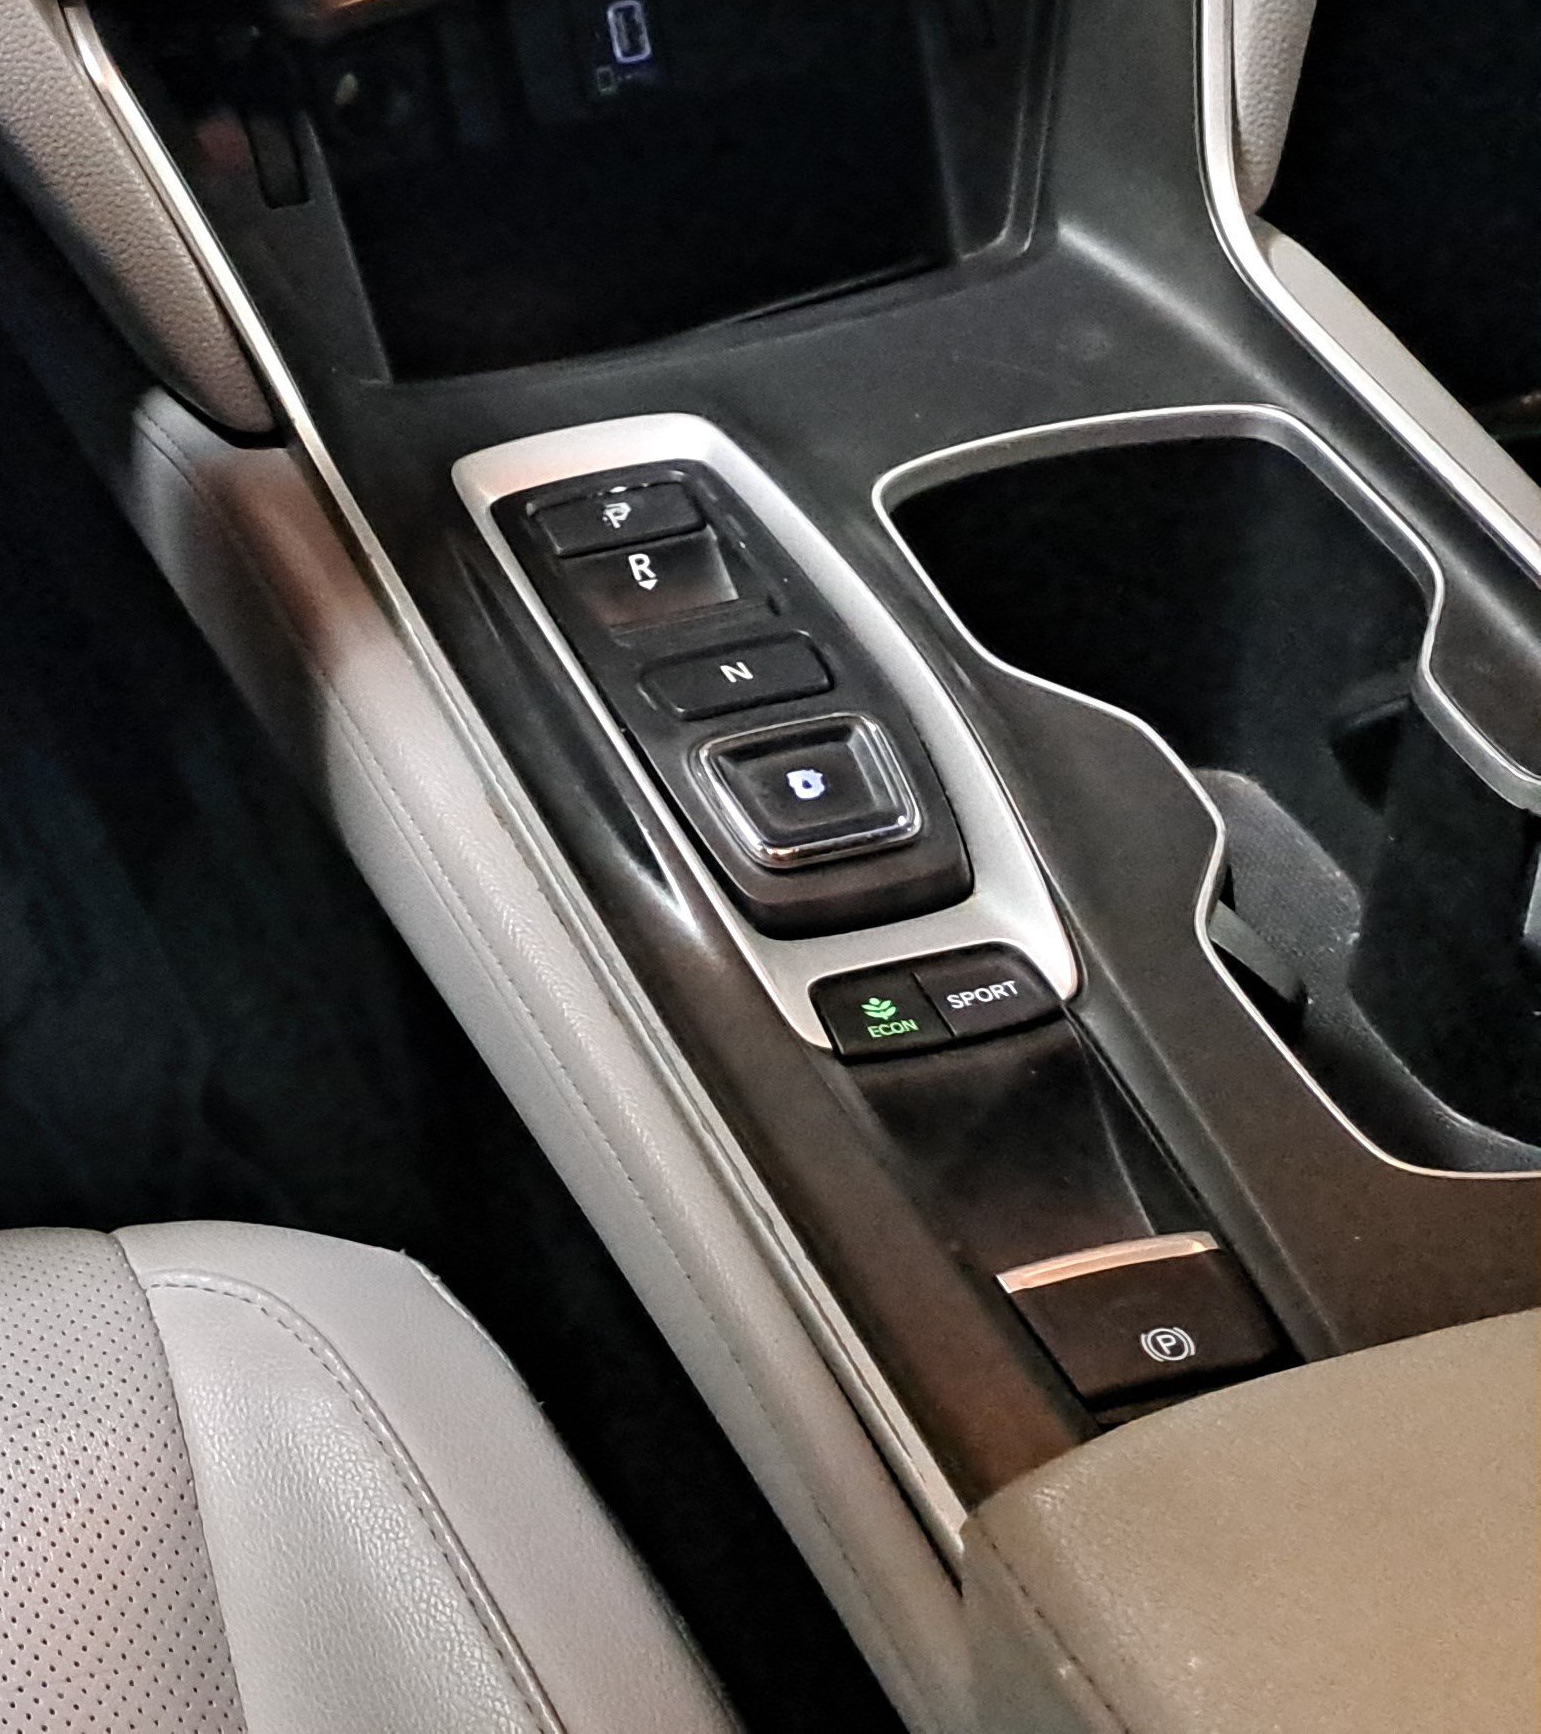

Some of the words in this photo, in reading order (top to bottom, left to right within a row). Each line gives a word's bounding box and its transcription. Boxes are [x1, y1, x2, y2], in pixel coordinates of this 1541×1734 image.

[602, 501, 632, 529] P
[628, 552, 657, 582] R
[719, 661, 755, 683] N
[946, 980, 1018, 1010] SPORT
[867, 1018, 919, 1039] ECON
